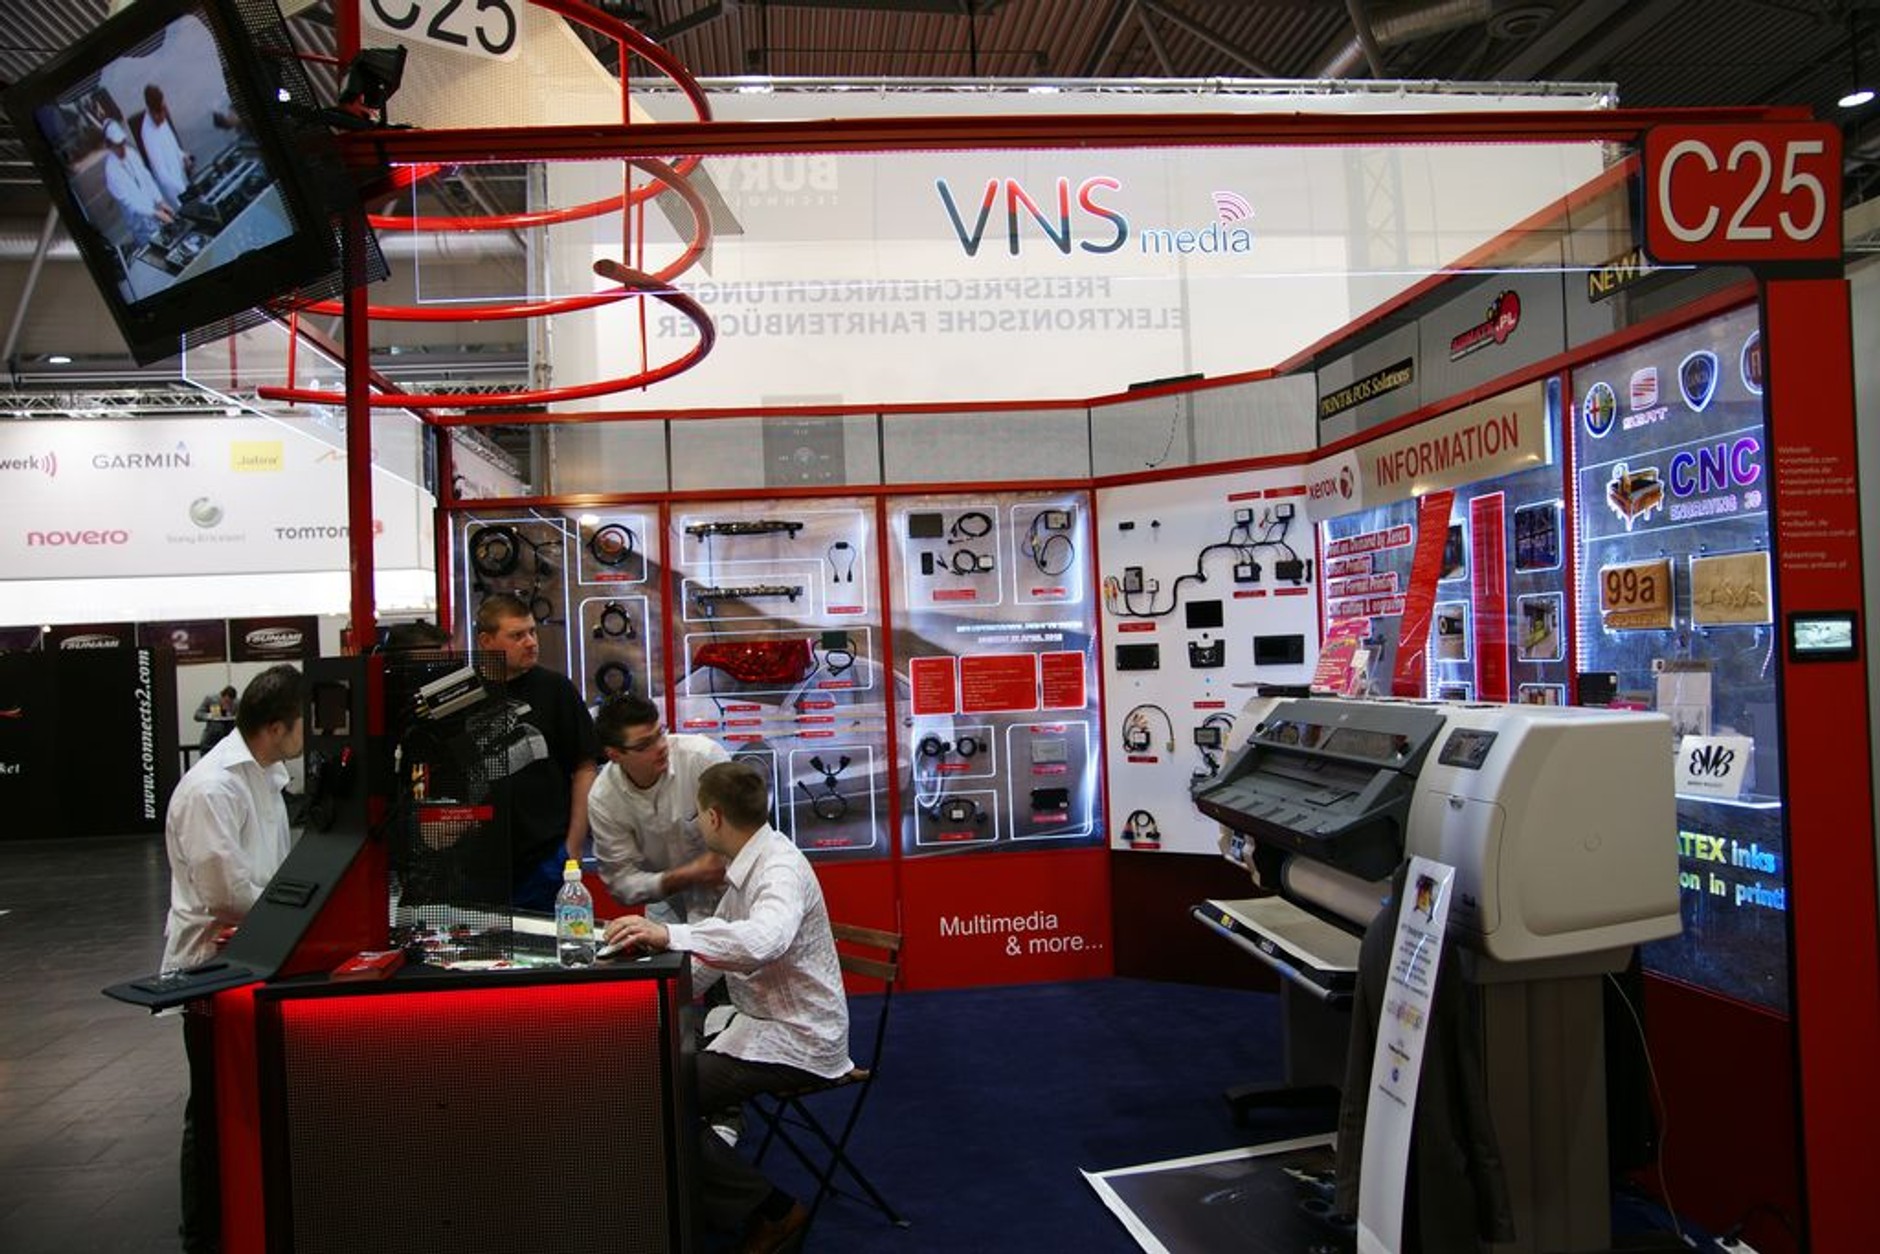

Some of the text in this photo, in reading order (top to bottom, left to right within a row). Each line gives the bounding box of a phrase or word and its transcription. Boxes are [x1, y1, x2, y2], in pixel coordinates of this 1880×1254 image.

[1658, 139, 1826, 242] C25
[936, 176, 1252, 257] VNS media
[92, 452, 191, 469] GARMIN
[1376, 411, 1519, 487] INFORMATION
[1669, 437, 1760, 497] CNC
[1308, 479, 1339, 499] xerox
[27, 530, 129, 547] novero
[1607, 568, 1655, 605] 99a
[135, 650, 156, 819] www.connects2.com
[1677, 831, 1775, 873] TEX inks
[1709, 873, 1726, 897] in
[940, 910, 1058, 937] Multimedia
[1006, 935, 1103, 956] & more...
